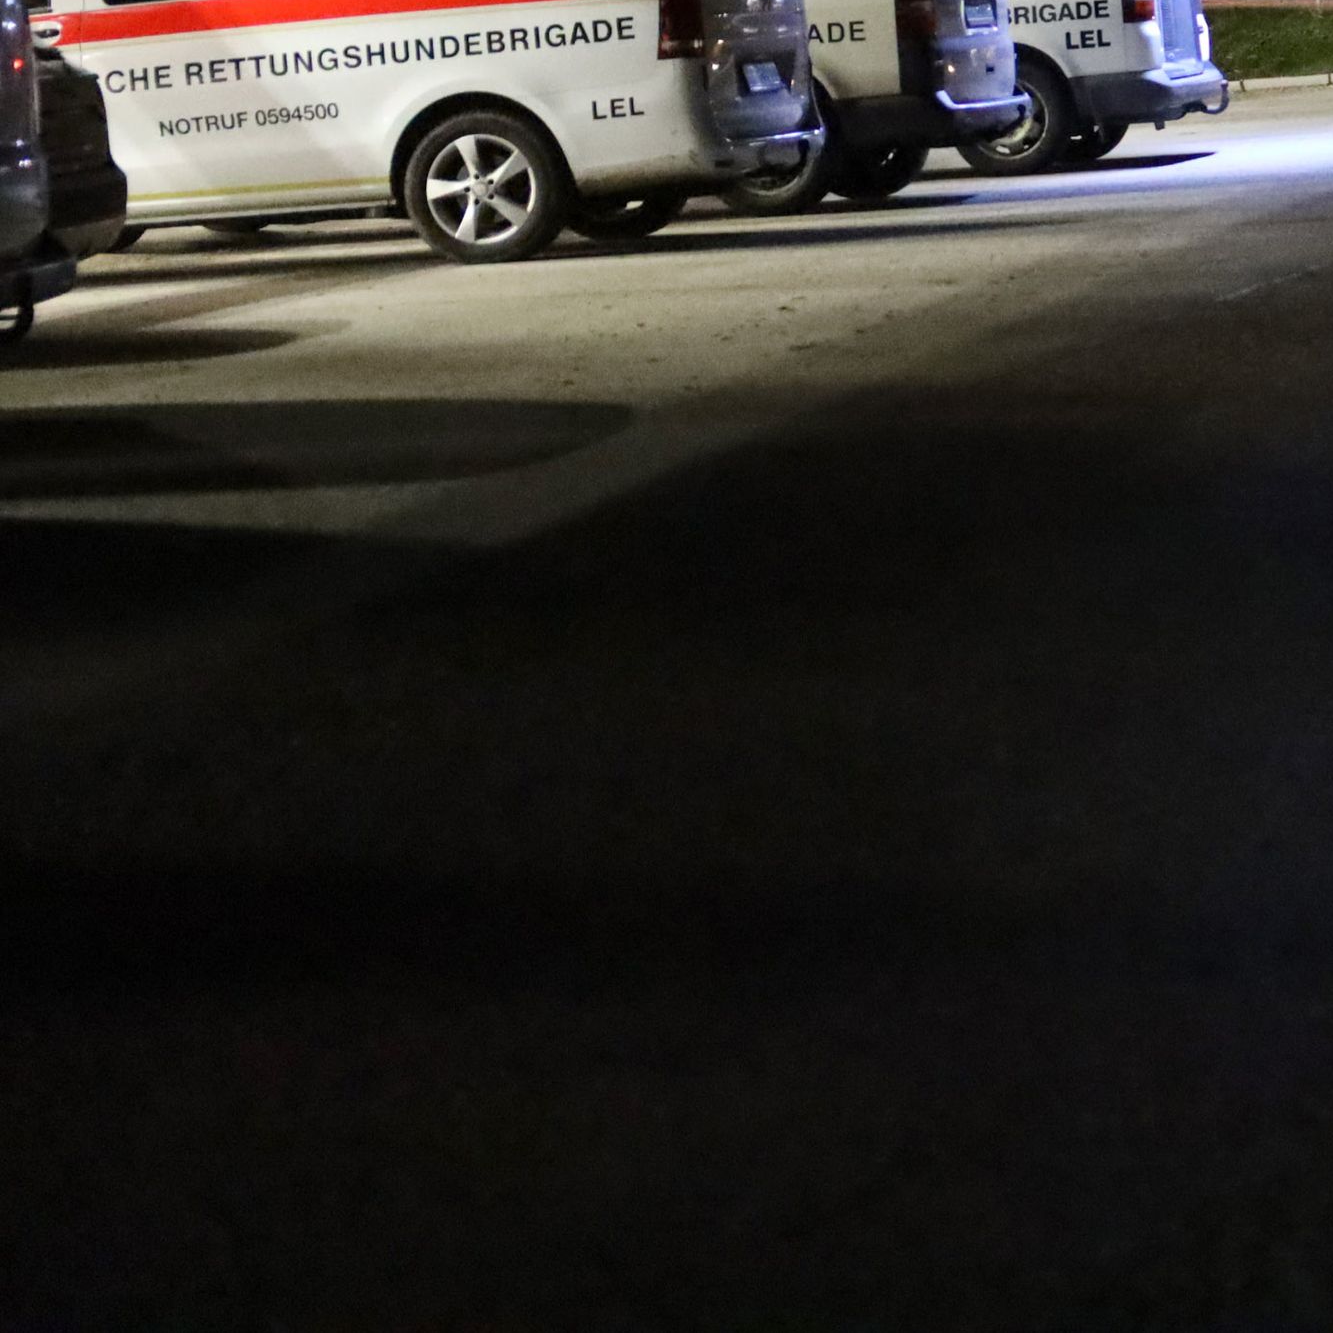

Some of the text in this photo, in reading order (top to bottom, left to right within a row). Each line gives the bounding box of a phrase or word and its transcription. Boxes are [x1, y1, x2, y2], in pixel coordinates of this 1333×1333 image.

[808, 21, 866, 44] ADE
[1065, 29, 1111, 50] LEL
[185, 16, 637, 86] RETTUNGSHUNDEBRIGADE
[158, 102, 340, 137] NOTRUF 0594500
[591, 97, 645, 120] LEL
